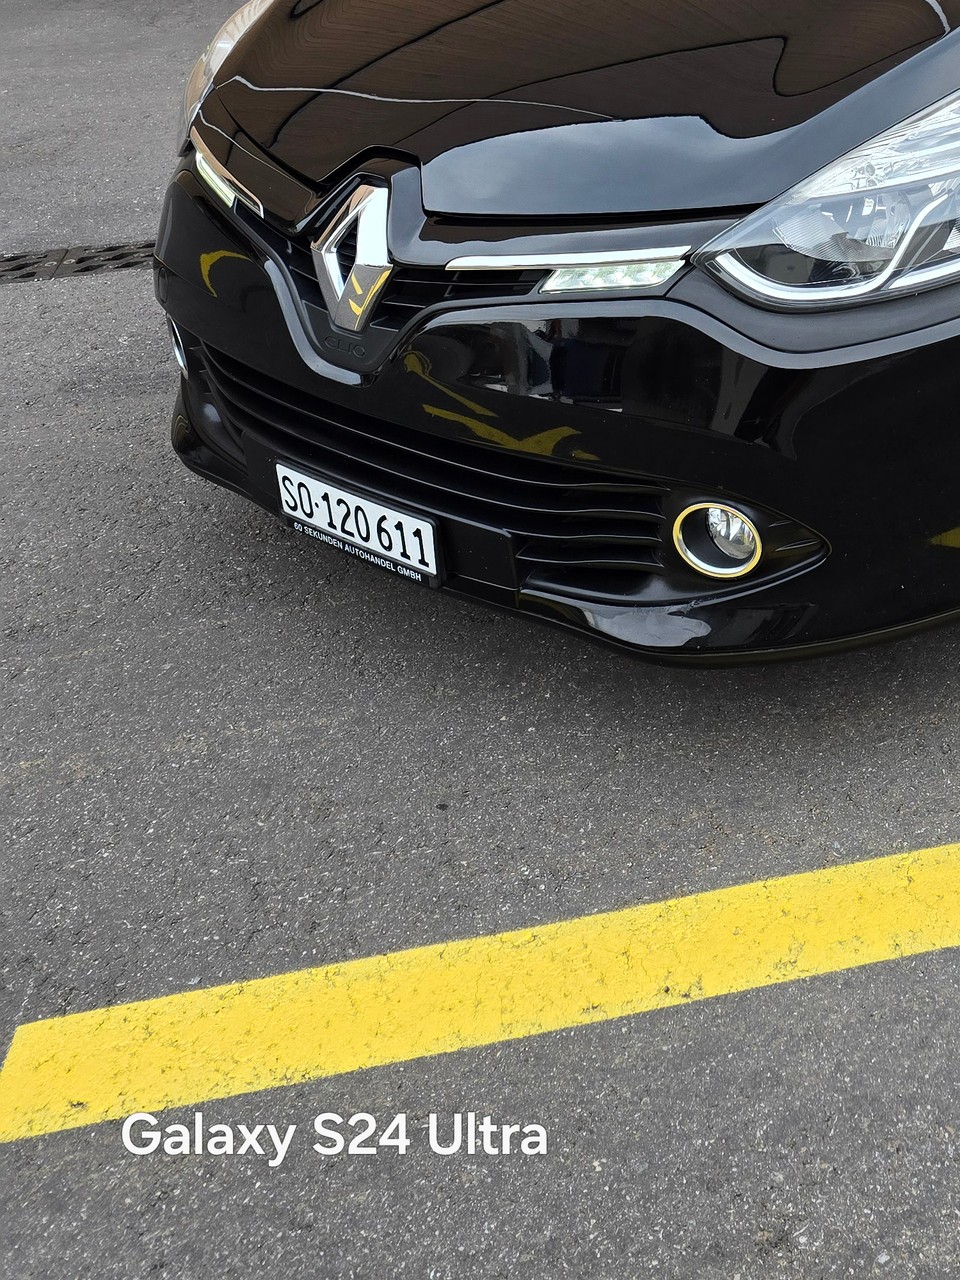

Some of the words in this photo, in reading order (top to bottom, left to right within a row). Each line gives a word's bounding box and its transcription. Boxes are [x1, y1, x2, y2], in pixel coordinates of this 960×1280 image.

[324, 335, 366, 358] CLIO
[293, 522, 303, 532] 60
[304, 526, 343, 550] SEKUNDEN
[344, 543, 396, 572] AUTOHANDEL
[397, 565, 422, 582] GMBH
